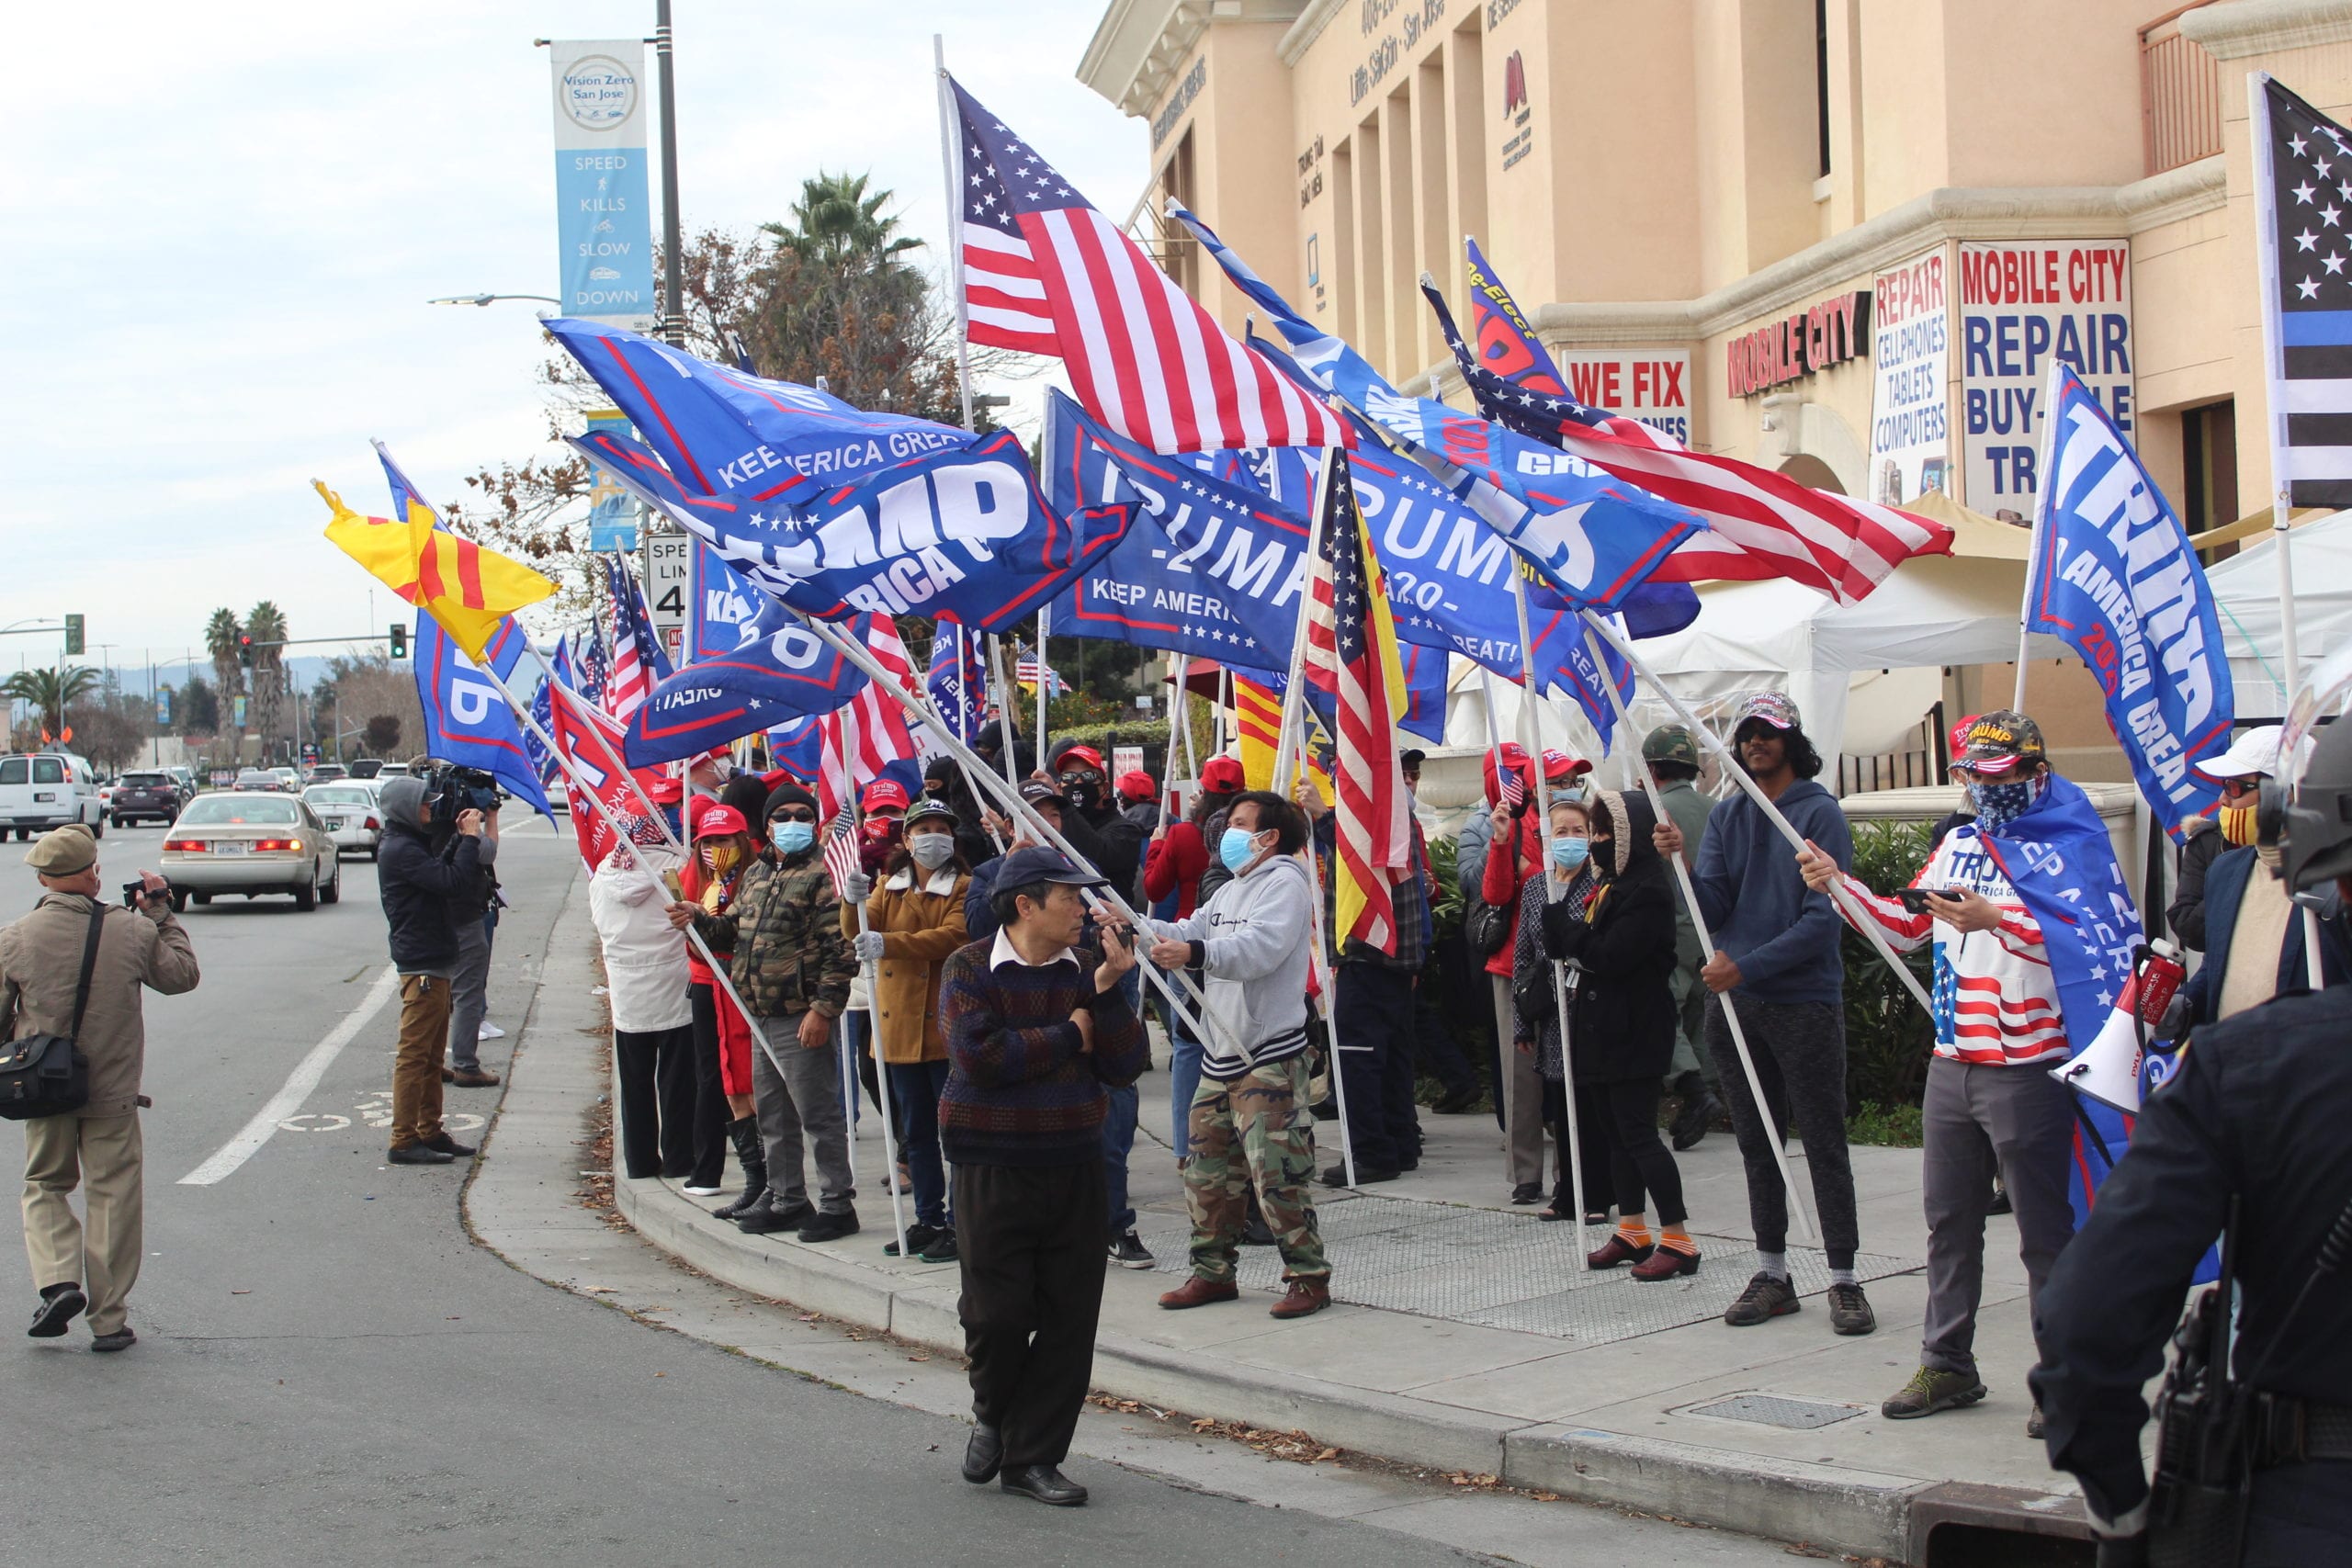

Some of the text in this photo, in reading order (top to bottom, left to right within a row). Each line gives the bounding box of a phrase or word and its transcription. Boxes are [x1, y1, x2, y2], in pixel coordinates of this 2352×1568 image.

[563, 74, 635, 86] Vision Zero
[572, 88, 625, 101] San Jose
[574, 156, 627, 171] SPEED
[580, 197, 626, 212] KILLS
[578, 242, 631, 257] SLOW
[1877, 256, 1945, 329] REPAIR
[1962, 248, 2126, 306] MOBILE CITY
[576, 290, 639, 306] DOWN
[1727, 290, 1858, 400] MOBILE CITY
[1877, 314, 1945, 370] CELLPHONES
[1965, 313, 2131, 378] REPAIR
[1570, 361, 1685, 409] WE FIX
[1888, 362, 1934, 410] TABLETS
[1876, 402, 1946, 454] COMPUTERS
[717, 445, 782, 491] KEE
[653, 544, 687, 558] SPE
[656, 585, 685, 617] 4
[1091, 578, 1147, 605] KEEP
[1968, 725, 2013, 743] TRUMP
[1949, 850, 2005, 884] TRU
[2132, 1050, 2143, 1078] PYLE
